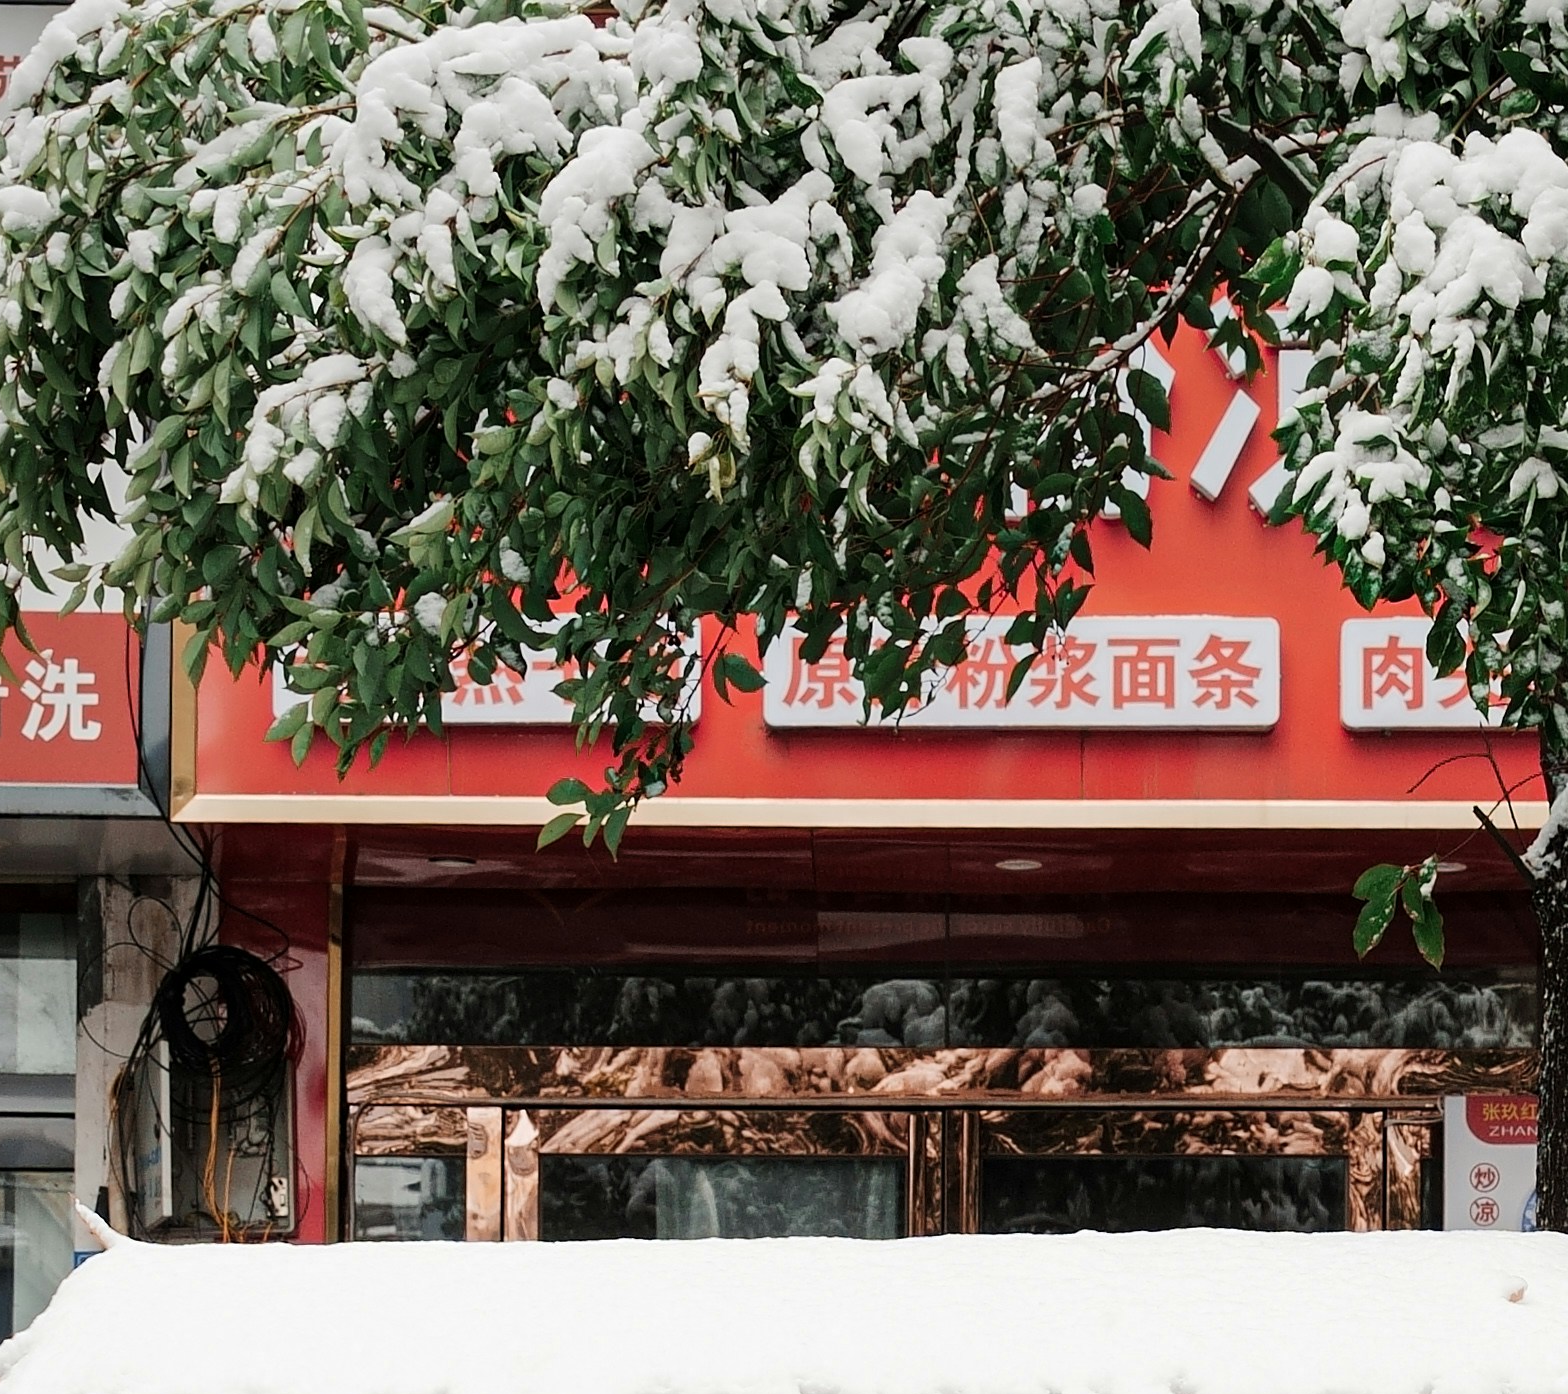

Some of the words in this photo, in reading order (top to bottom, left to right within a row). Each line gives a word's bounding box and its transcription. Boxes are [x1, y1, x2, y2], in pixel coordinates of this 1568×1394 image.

[782, 633, 1263, 713] 原粉浆面条
[1482, 1103, 1537, 1122] 张玖红
